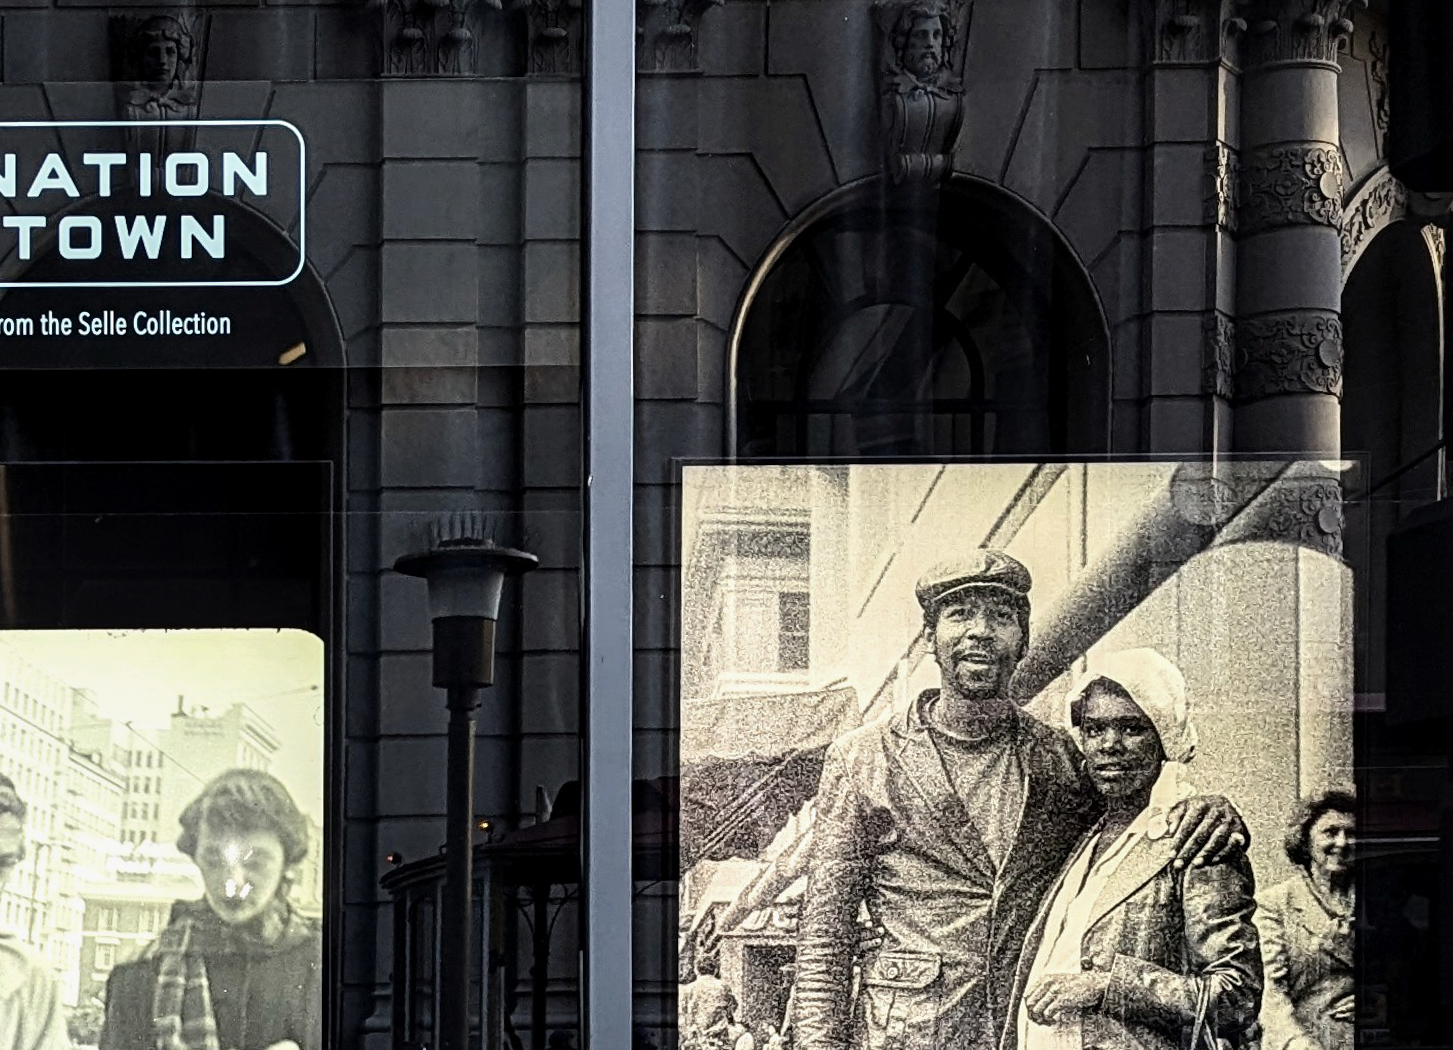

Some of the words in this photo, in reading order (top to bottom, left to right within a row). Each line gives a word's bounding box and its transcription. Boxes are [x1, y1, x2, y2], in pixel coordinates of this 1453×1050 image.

[39, 310, 73, 336] the
[77, 310, 128, 336] Selle
[132, 309, 232, 336] Collection
